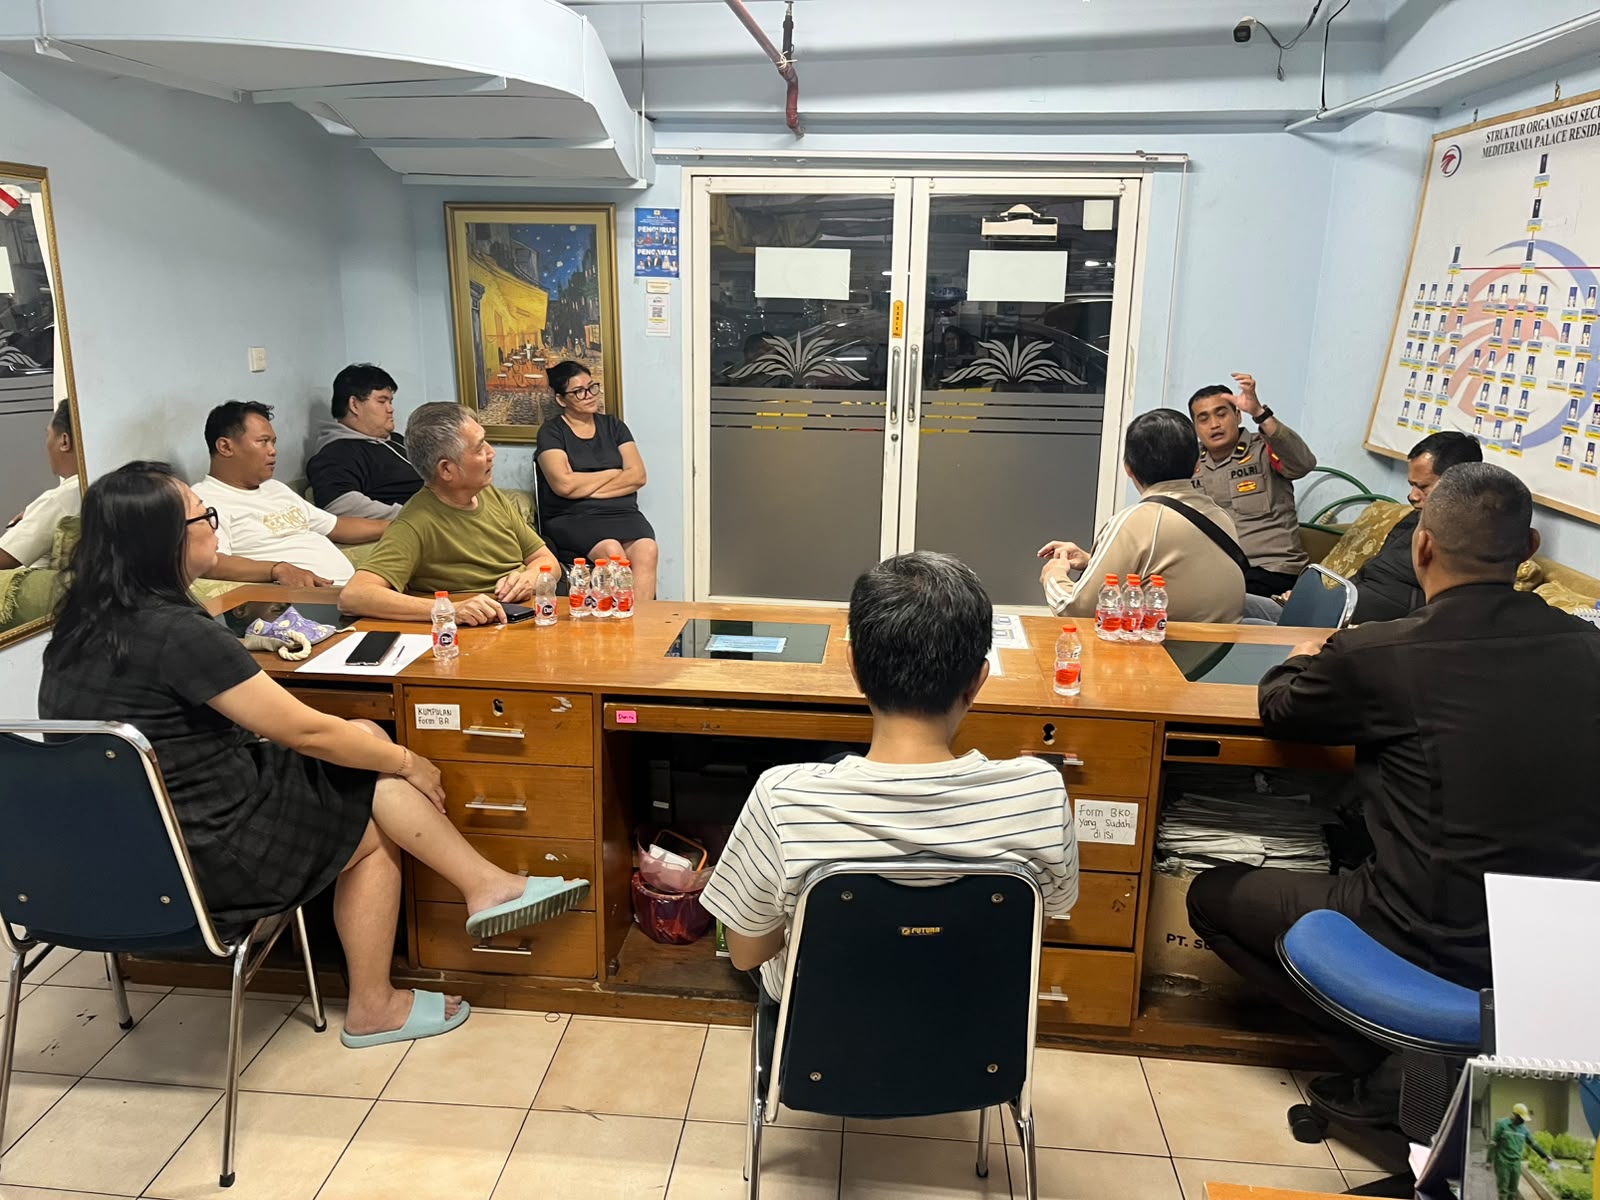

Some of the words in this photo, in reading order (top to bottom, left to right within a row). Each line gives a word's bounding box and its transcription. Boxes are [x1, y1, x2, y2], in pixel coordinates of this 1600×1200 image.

[1486, 124, 1526, 143] STRUKTUR
[1526, 111, 1579, 134] ORGANISASI
[1482, 137, 1533, 157] MEDITERANIA
[1534, 129, 1568, 148] PALACE
[1231, 465, 1258, 479] POLRI
[417, 707, 452, 716] KUMPULAN
[418, 716, 435, 725] Form
[1079, 803, 1104, 817] Form
[1110, 807, 1131, 818] BKO
[1105, 818, 1131, 829] Sudah
[1166, 933, 1188, 947] PT.
